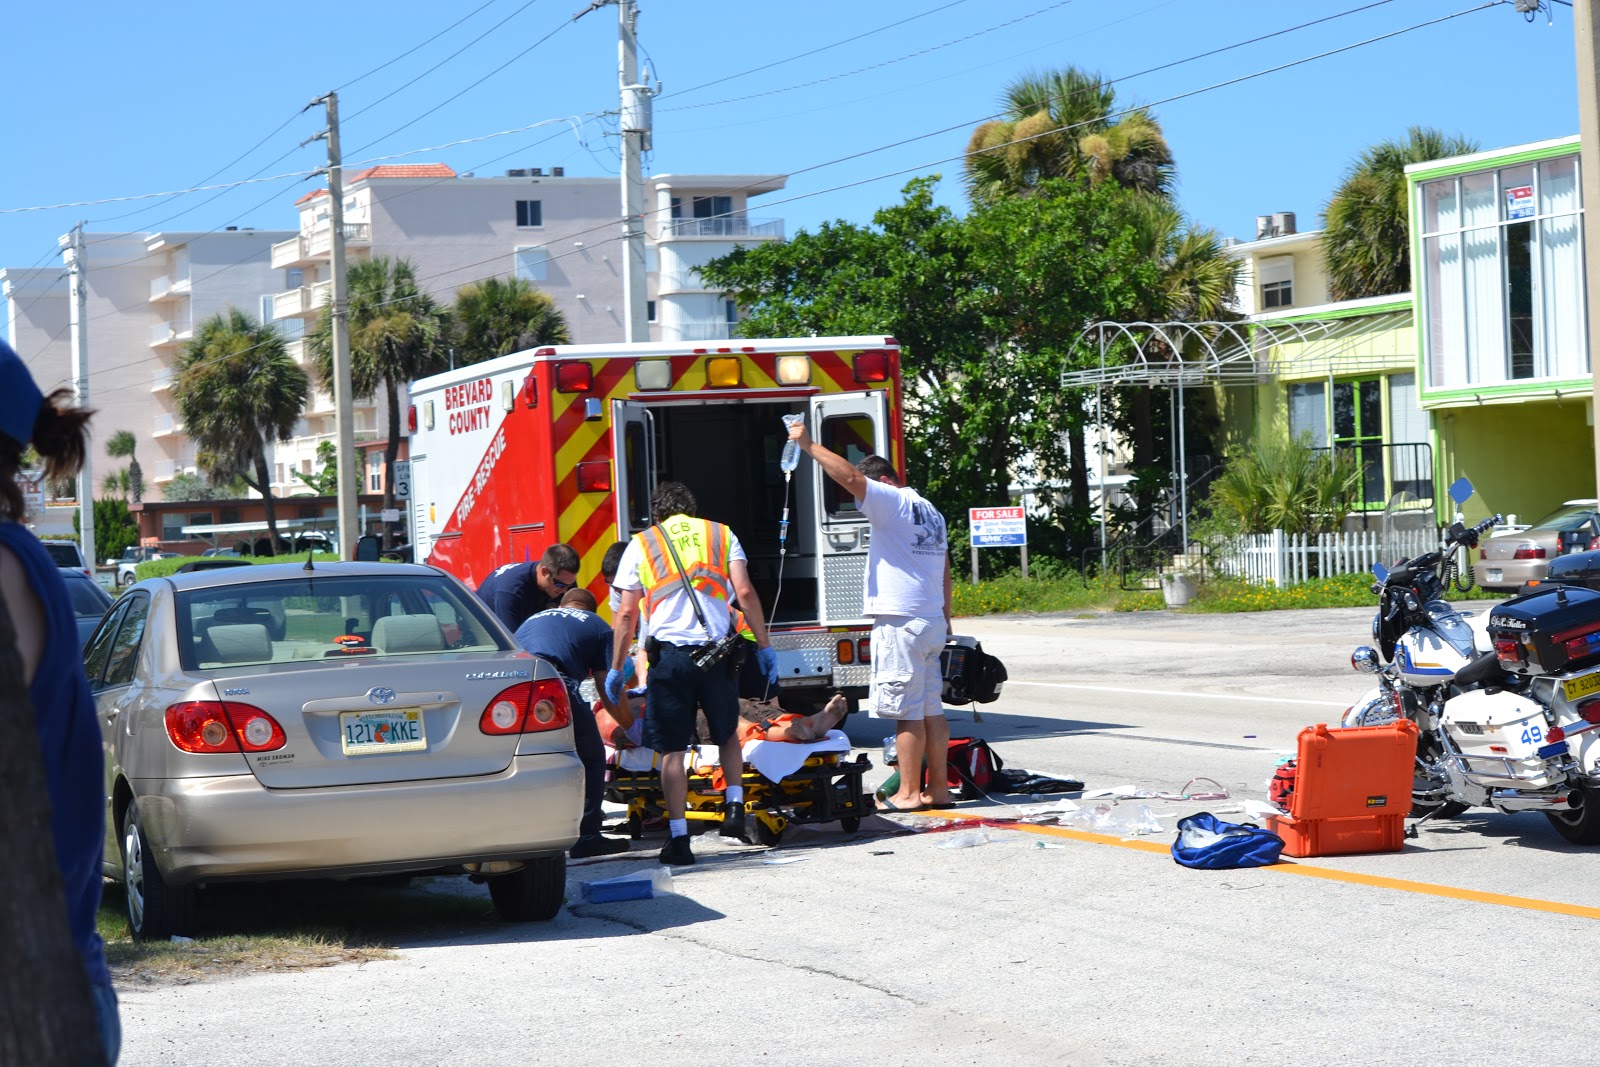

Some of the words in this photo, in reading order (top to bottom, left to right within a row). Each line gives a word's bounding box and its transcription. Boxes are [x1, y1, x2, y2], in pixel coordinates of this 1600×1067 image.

[445, 378, 493, 410] BREVARD
[449, 405, 490, 435] COUNTY
[456, 426, 507, 529] FIRE-RESCUE
[976, 510, 995, 519] FOR
[996, 509, 1019, 518] SALE
[670, 521, 691, 534] CB
[223, 687, 250, 696] TOYOTA
[1567, 682, 1576, 694] CY
[346, 723, 373, 744] 121
[391, 720, 419, 741] KKE
[1521, 725, 1542, 745] 49
